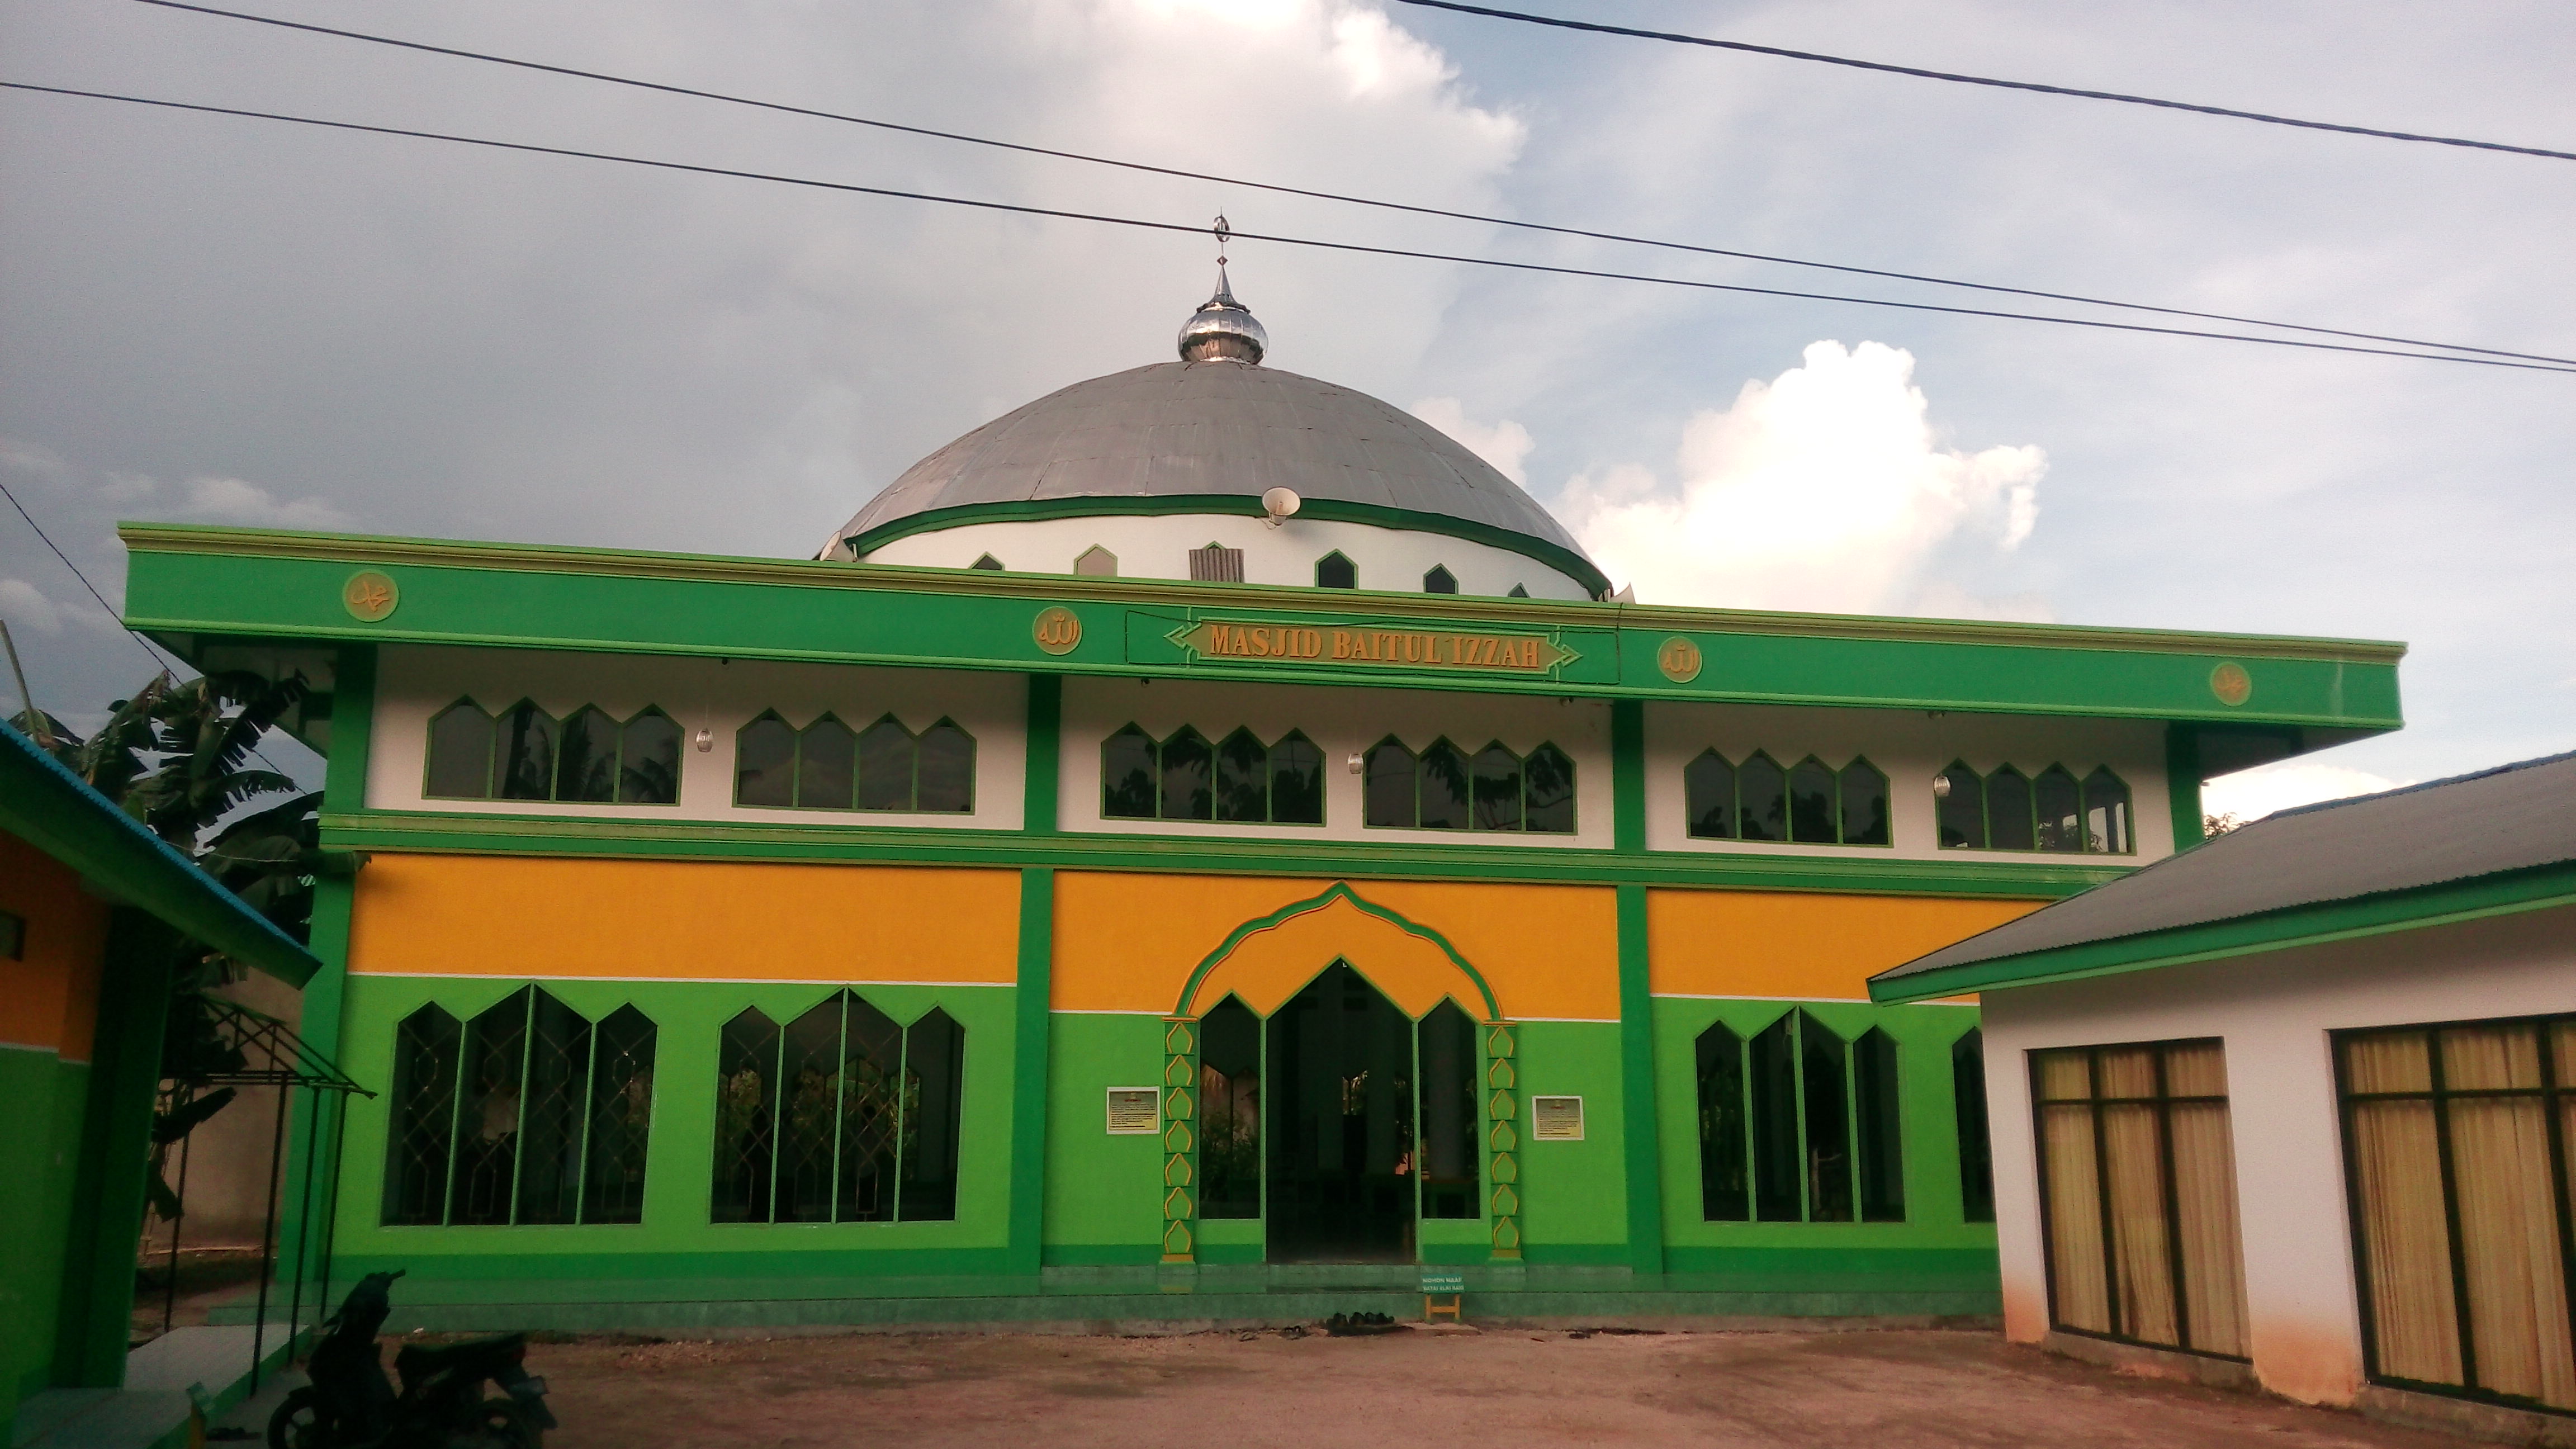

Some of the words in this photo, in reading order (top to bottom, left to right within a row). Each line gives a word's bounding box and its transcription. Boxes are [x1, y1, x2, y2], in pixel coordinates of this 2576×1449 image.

[1039, 612, 1079, 645] الله
[1209, 624, 1323, 659] MASJID
[1332, 630, 1443, 664] BAITUL
